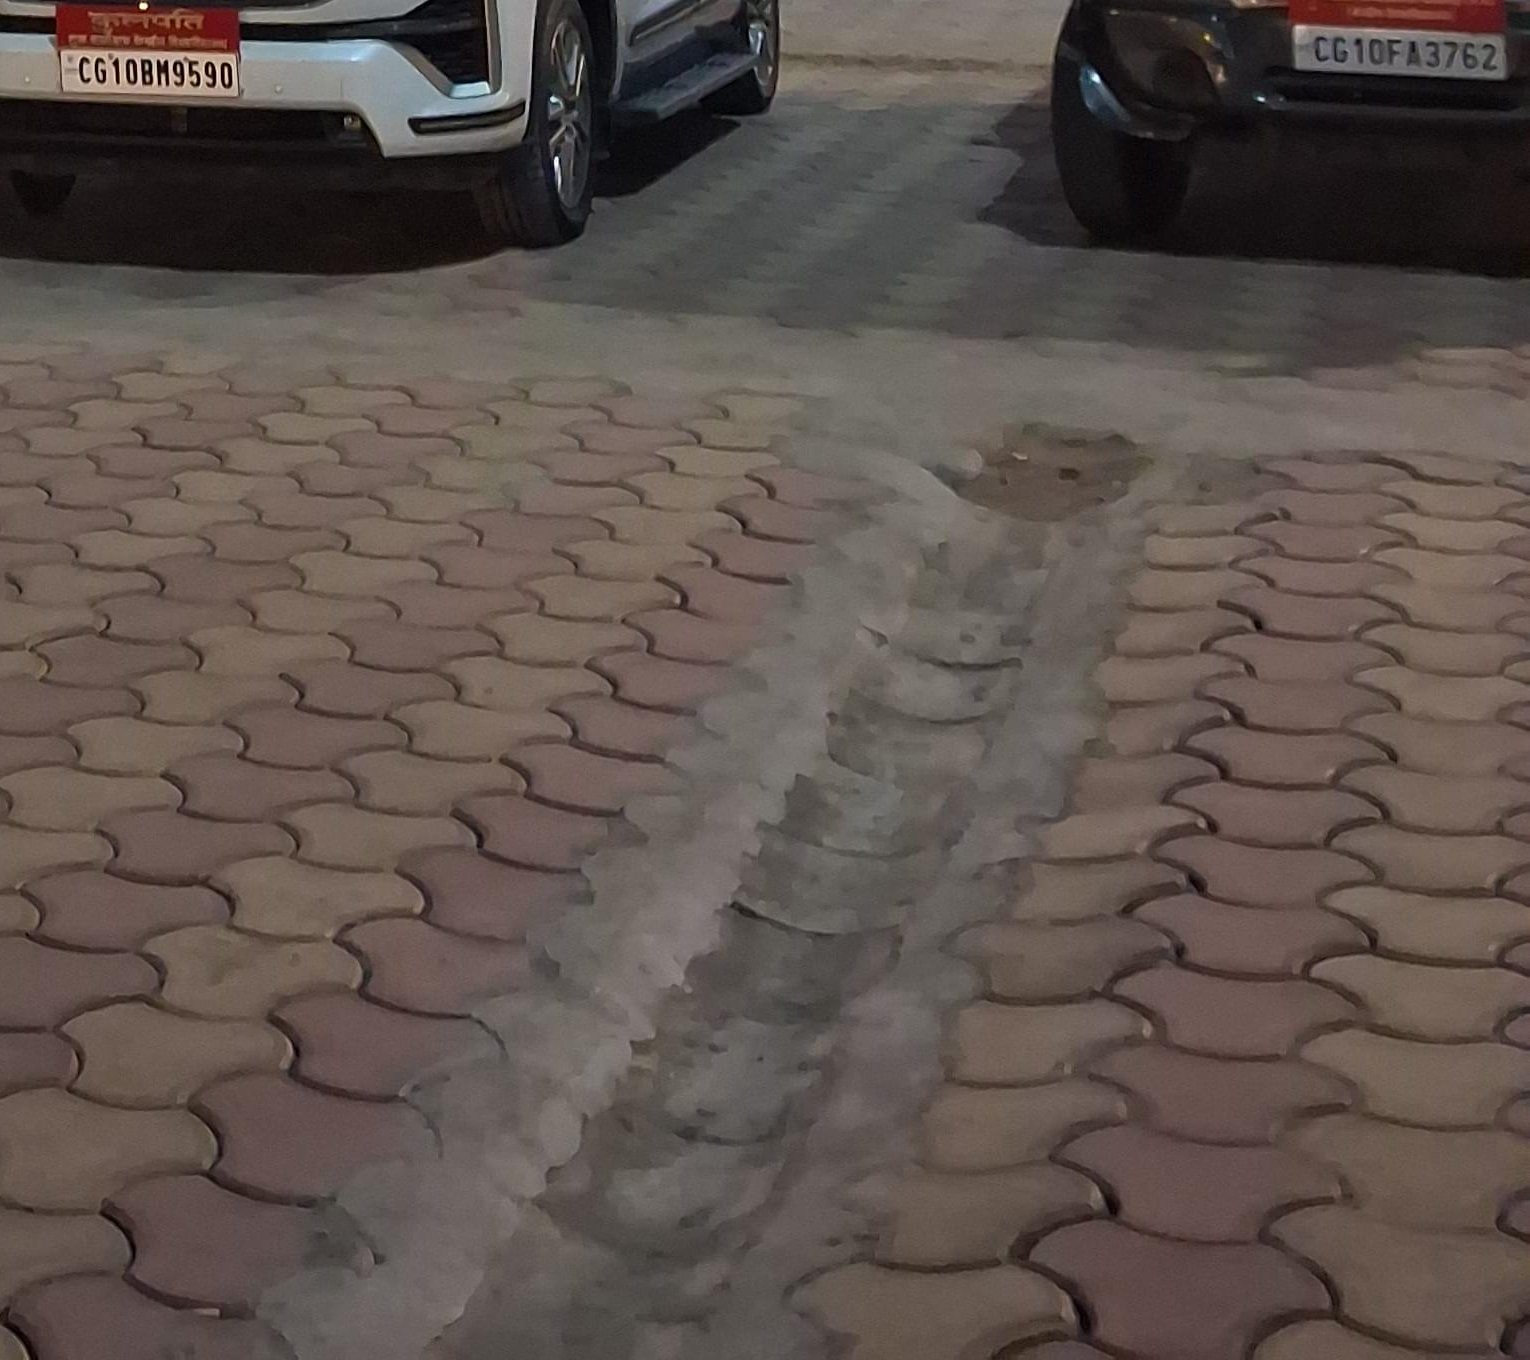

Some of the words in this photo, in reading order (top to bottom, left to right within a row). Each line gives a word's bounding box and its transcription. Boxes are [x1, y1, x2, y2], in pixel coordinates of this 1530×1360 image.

[88, 8, 204, 35] कुलपति
[1314, 36, 1498, 71] CG10FA3762
[78, 56, 233, 90] CG10BM9590
